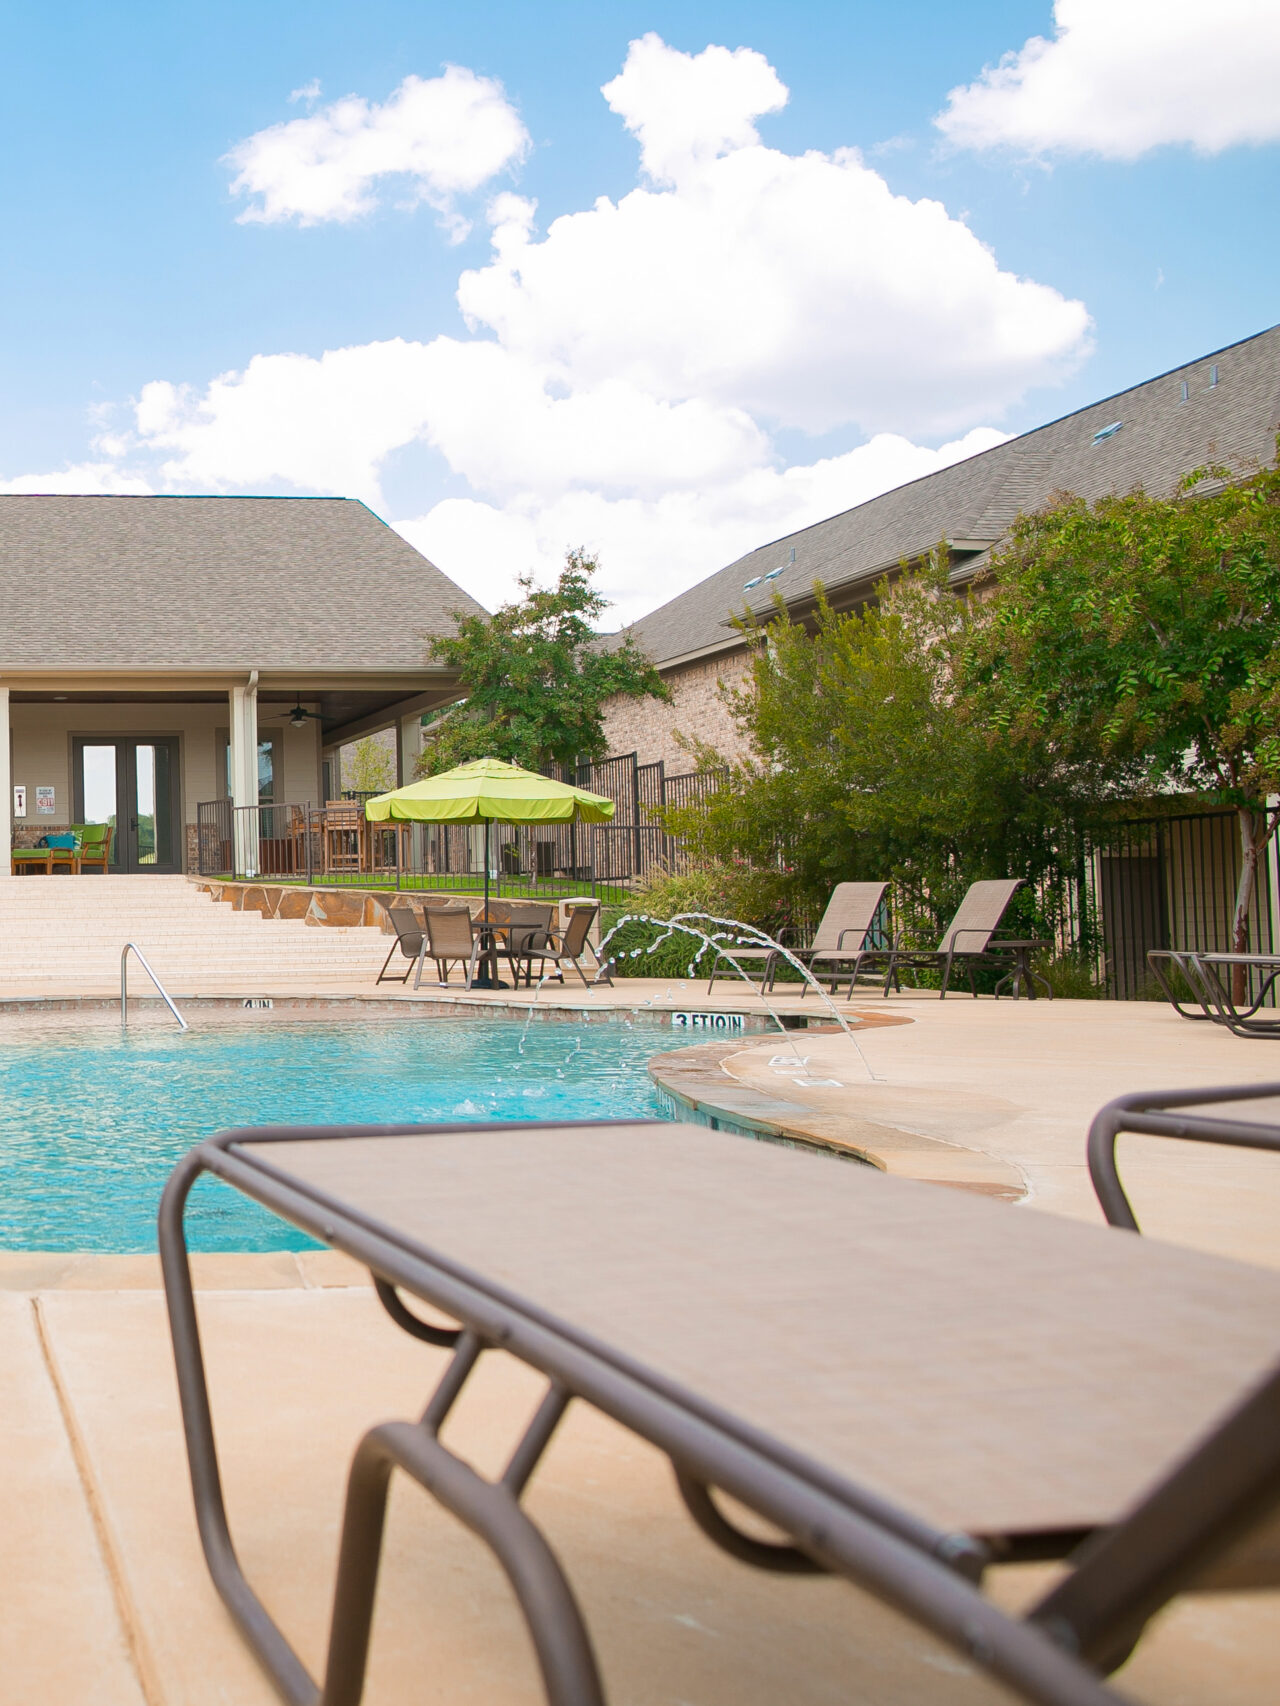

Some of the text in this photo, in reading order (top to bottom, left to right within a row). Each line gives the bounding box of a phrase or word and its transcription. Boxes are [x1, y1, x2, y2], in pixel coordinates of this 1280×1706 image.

[676, 1014, 687, 1026] 3
[692, 1014, 708, 1027] FT
[728, 1016, 741, 1029] IN
